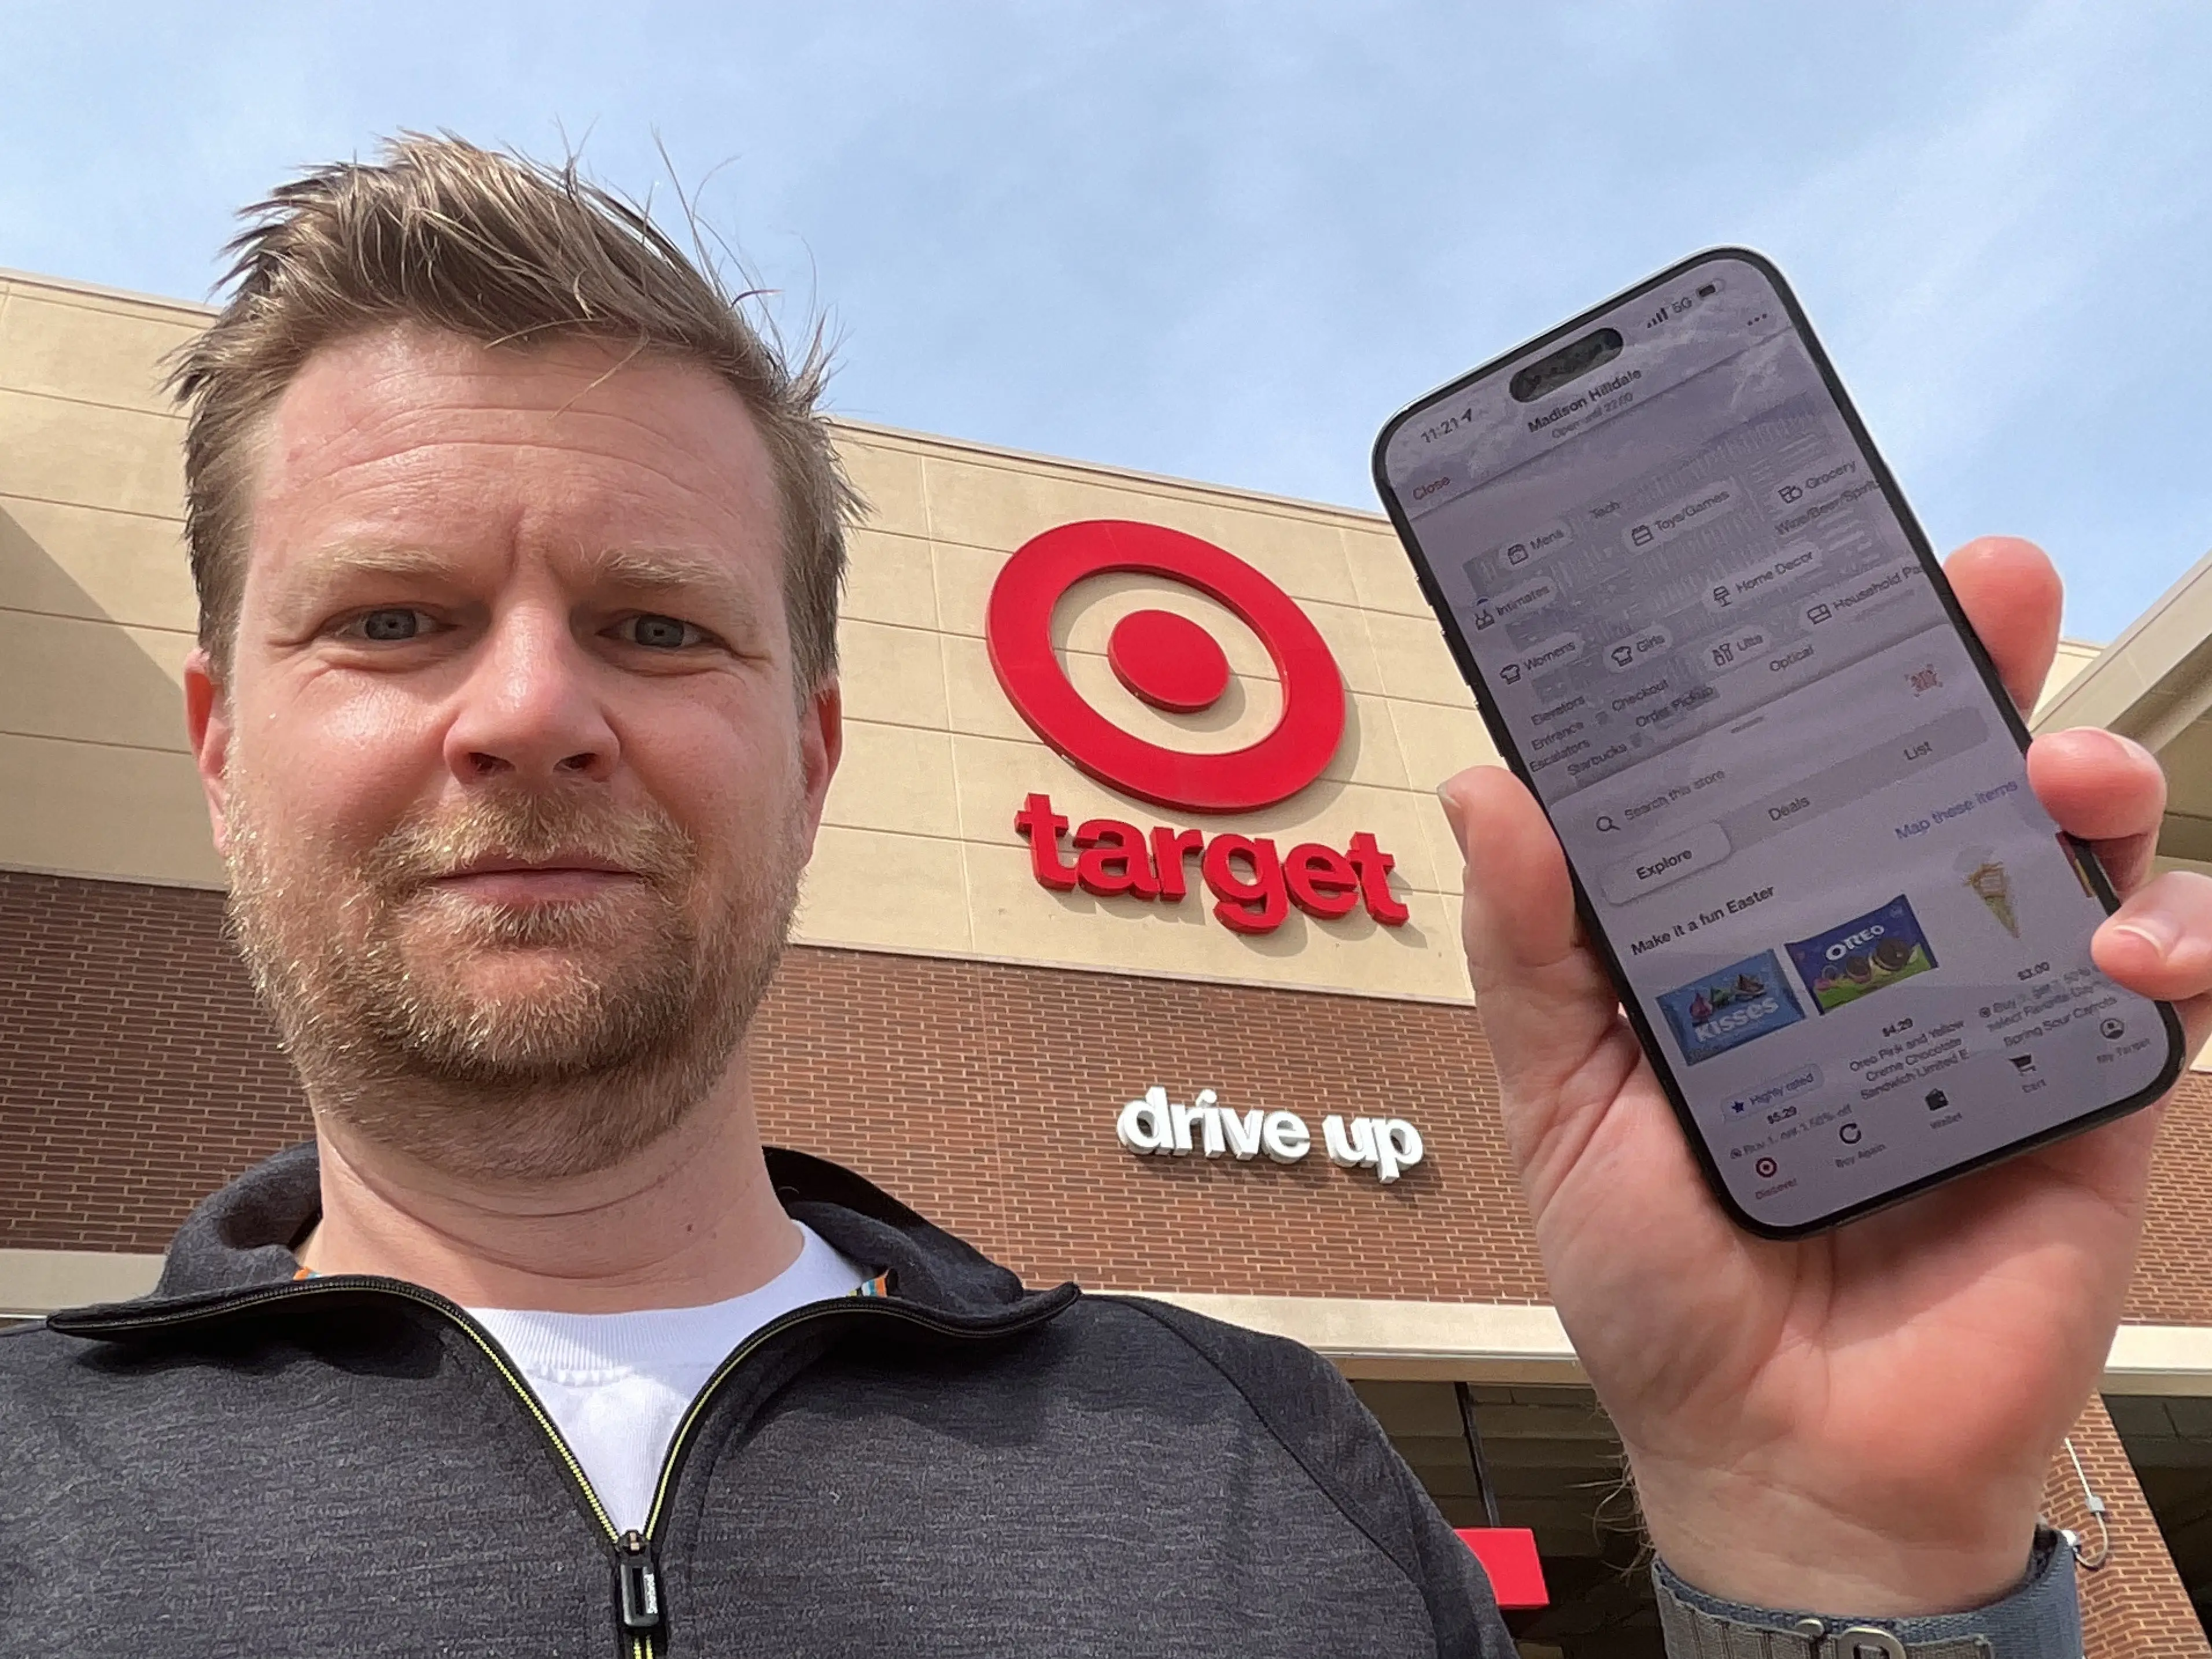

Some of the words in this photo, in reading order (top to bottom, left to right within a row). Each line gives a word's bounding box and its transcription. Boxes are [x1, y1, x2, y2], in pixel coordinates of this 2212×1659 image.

[1671, 294, 1693, 314] 5G
[1526, 395, 1588, 433] Madison
[1587, 365, 1643, 402] Hilldale
[1420, 415, 1459, 444] 11:21
[1411, 473, 1451, 502] Close
[1804, 459, 1859, 491] Grocery
[1654, 488, 1730, 533] Toys/Games
[1529, 526, 1563, 551] Mens
[1735, 569, 1774, 593] Home
[1774, 550, 1813, 576] Decor
[1832, 571, 1902, 612] Household
[1901, 561, 1923, 578] Pa
[1495, 584, 1550, 616] Intimates
[1523, 640, 1576, 671] Womens
[1635, 632, 1665, 653] Girls
[1767, 643, 1816, 674] Optical
[1530, 695, 1584, 725] Elevators
[1610, 677, 1669, 713] Checkout
[1531, 720, 1584, 751] Entrance
[1901, 739, 1933, 762] List
[1529, 738, 1591, 772] Escalators
[1566, 741, 1628, 776] Starbucks
[1624, 793, 1668, 820] Search
[1667, 783, 1691, 801] this
[1691, 769, 1726, 791] store
[1767, 794, 1810, 823] Deals
[1893, 815, 1931, 840] Map
[1929, 795, 1975, 825] these
[1974, 777, 2018, 806] items
[1015, 792, 1409, 935] target
[1635, 846, 1694, 882] Explore
[1629, 928, 1672, 956] Make
[1671, 923, 1685, 938] it
[1687, 920, 1698, 932] a
[1698, 905, 1726, 926] fun
[1725, 883, 1777, 914] Easter
[1822, 921, 1886, 964] OREO
[1693, 996, 1780, 1044] KISSES
[1848, 1053, 1879, 1072] Oreo
[1904, 1033, 1928, 1049] and
[1865, 1060, 1905, 1082] Creme
[1117, 1086, 1311, 1164] drive
[1322, 1114, 1425, 1184] up
